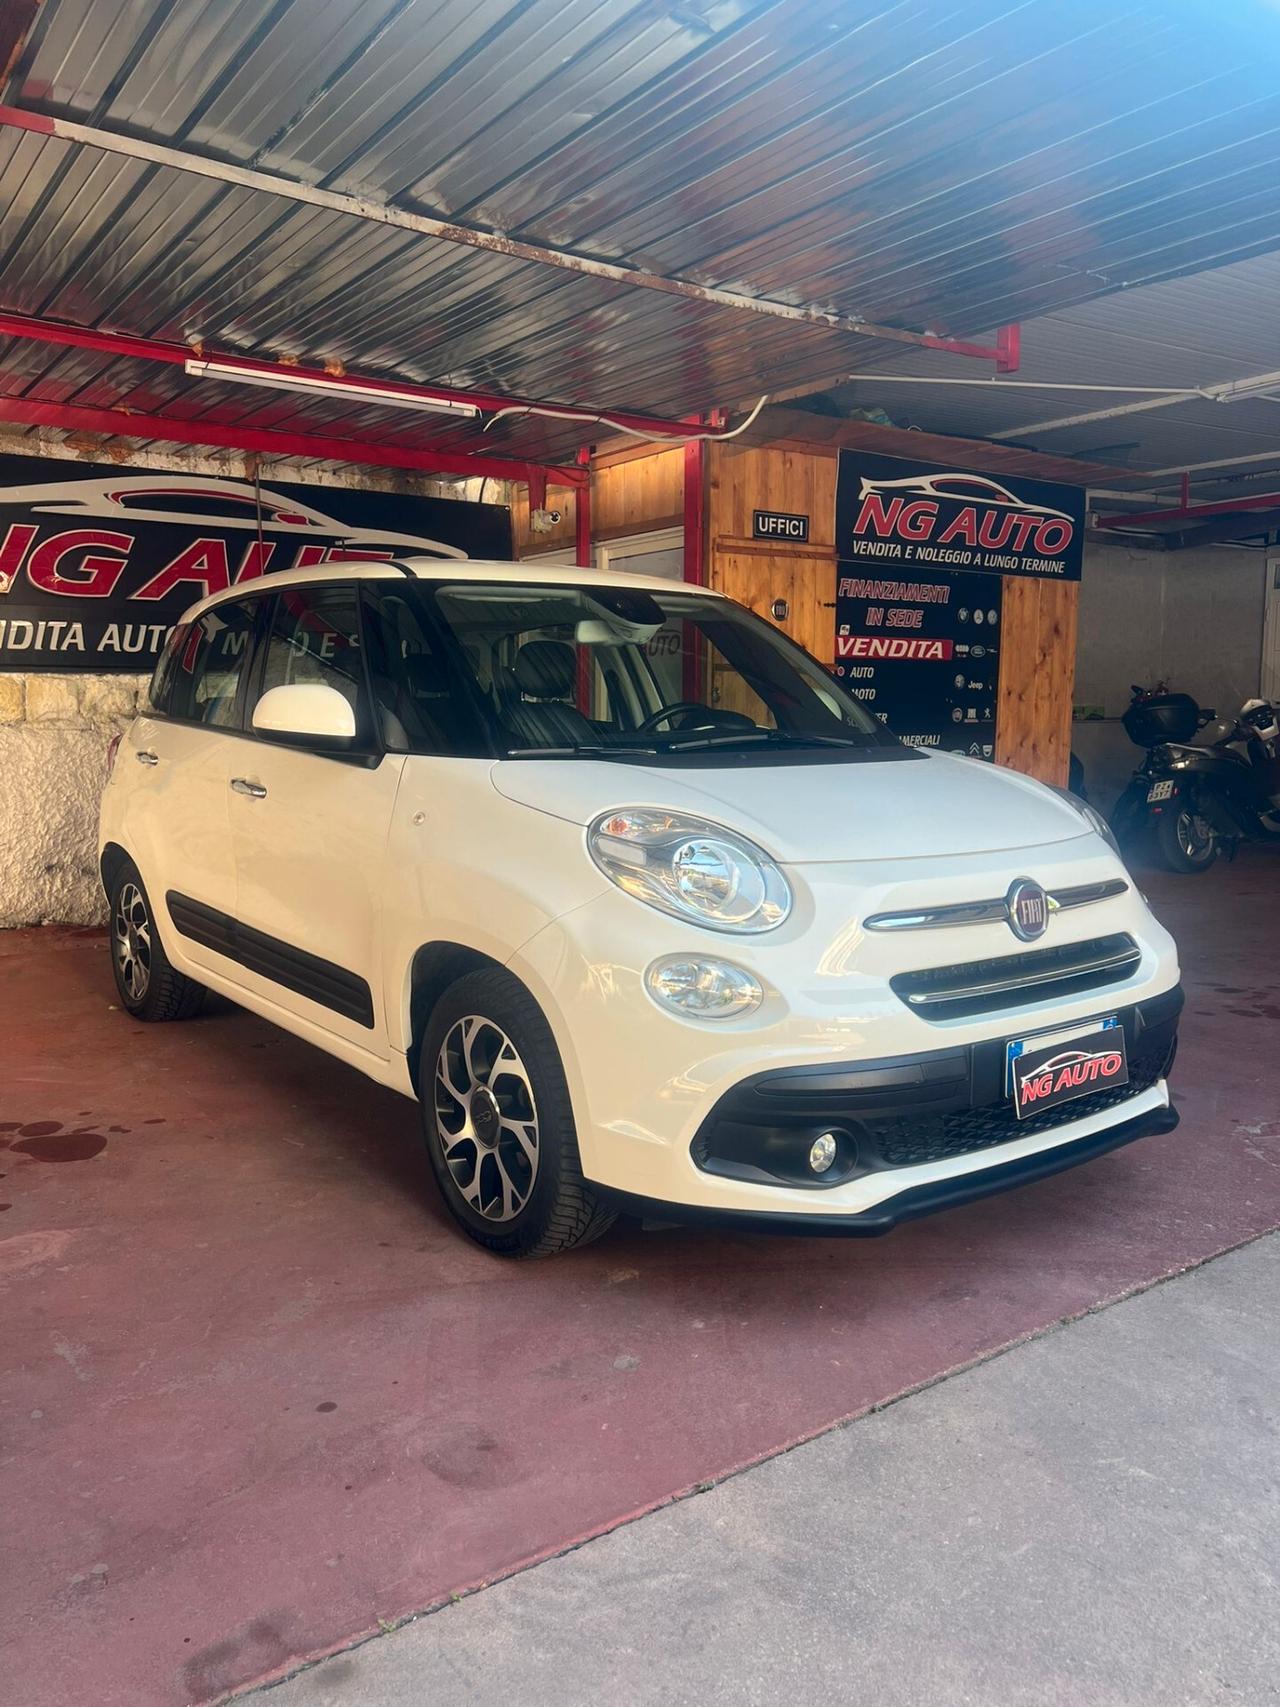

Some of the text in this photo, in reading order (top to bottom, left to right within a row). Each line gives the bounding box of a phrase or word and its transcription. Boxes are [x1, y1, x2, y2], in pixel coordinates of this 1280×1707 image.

[758, 516, 803, 536] UFFICI
[853, 495, 1073, 555] NG AUTO
[853, 540, 1066, 574] VENDITA E NOLEGGIO A LUNGO TERMINE
[839, 578, 950, 604] FINANZIAMENTI
[866, 607, 924, 628] IN SEDE
[837, 638, 944, 658] VENDITA
[850, 666, 874, 679] AUTO
[967, 680, 983, 690] Jeep
[1021, 898, 1043, 925] FIAT
[1021, 1054, 1122, 1105] NG AUTO
